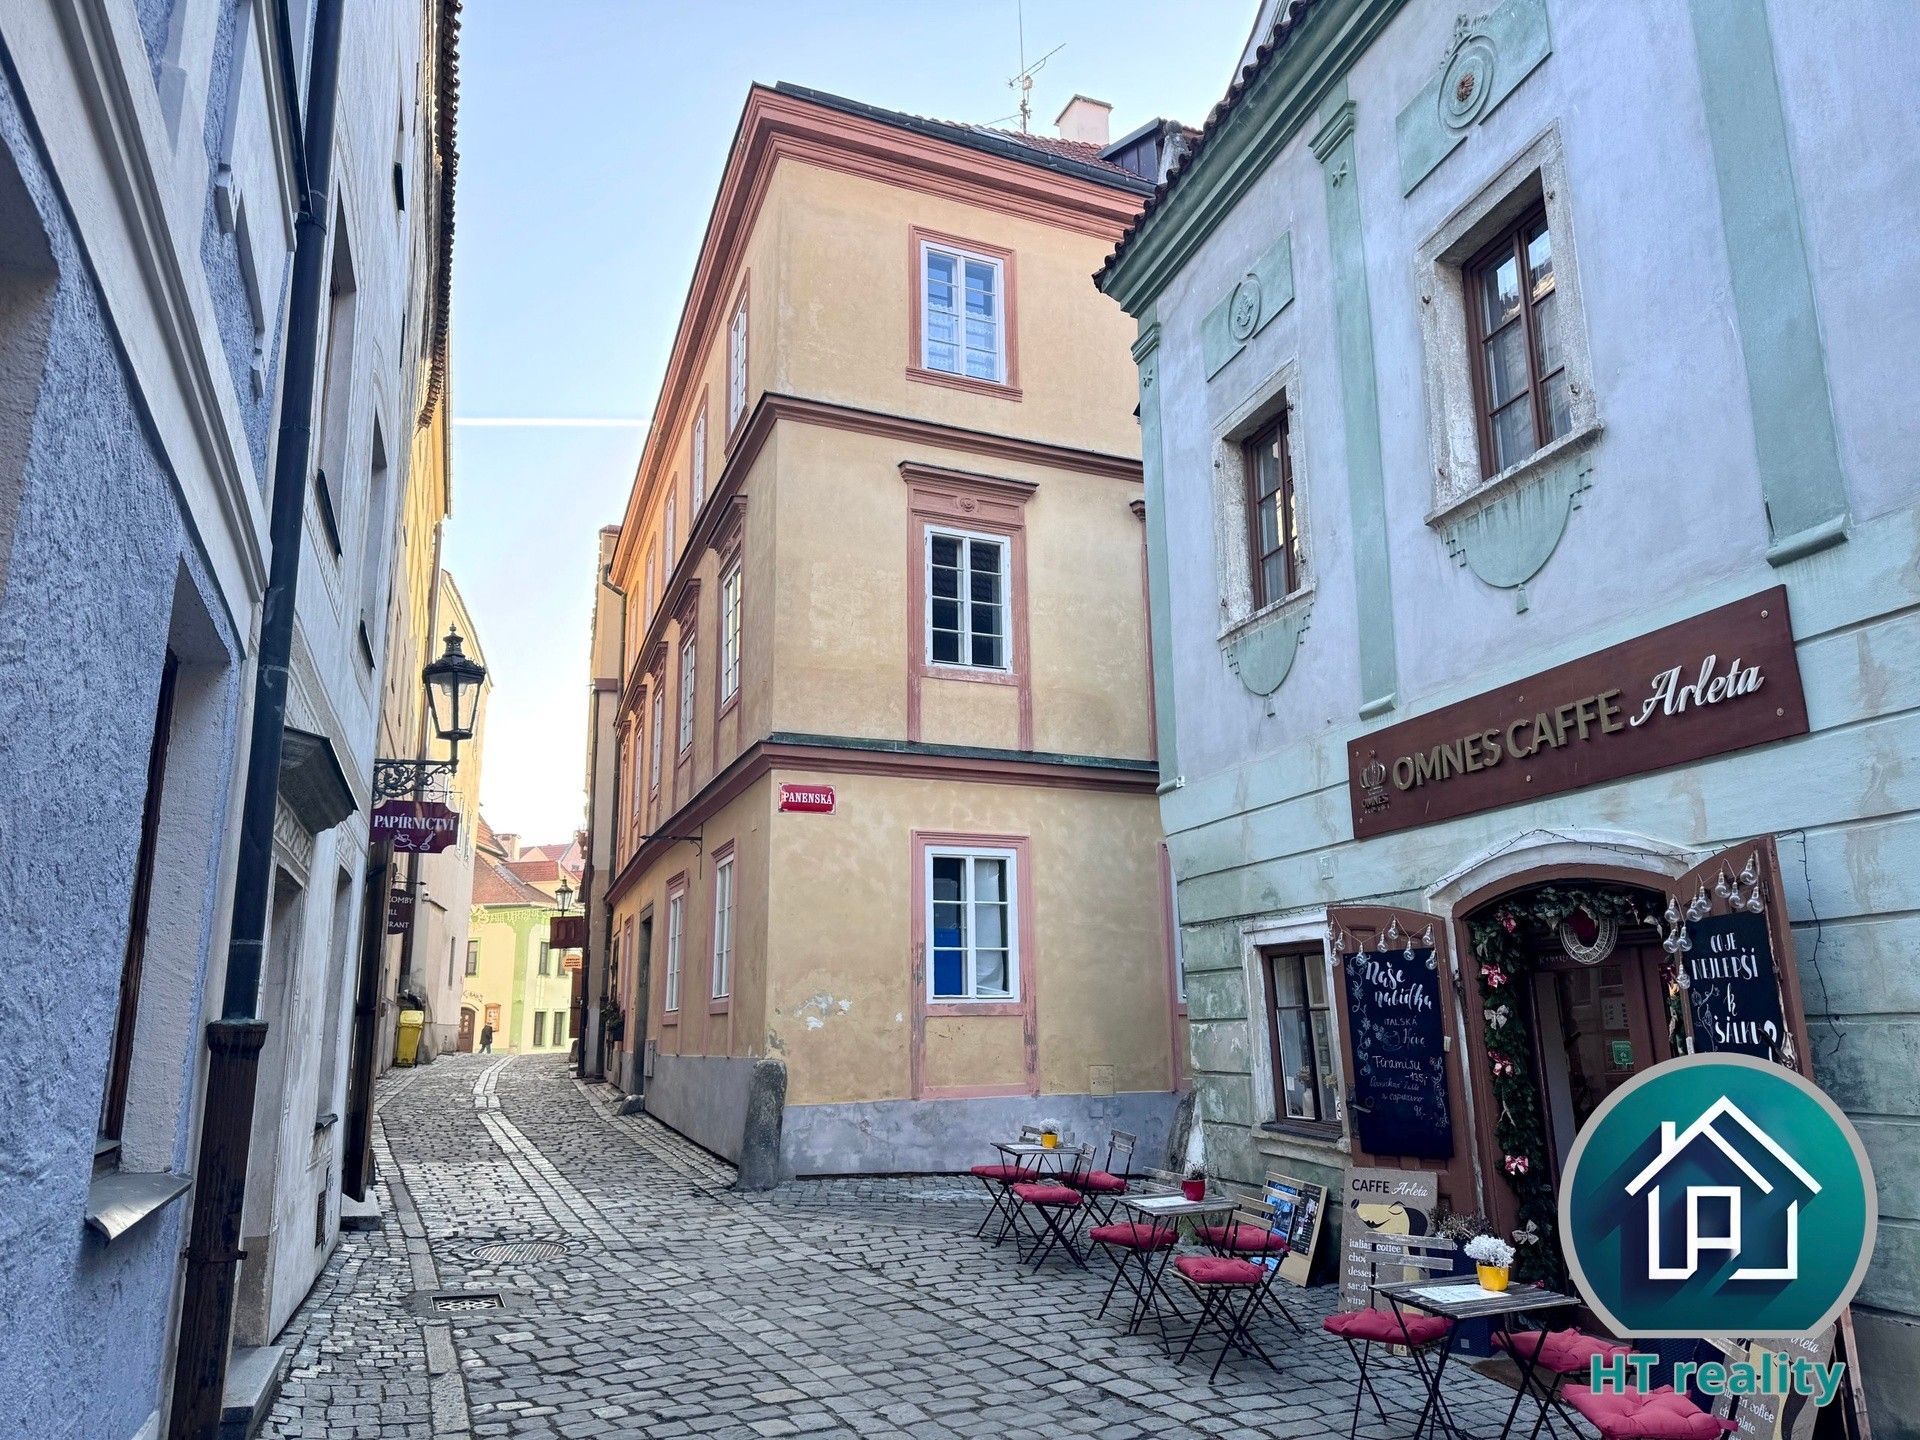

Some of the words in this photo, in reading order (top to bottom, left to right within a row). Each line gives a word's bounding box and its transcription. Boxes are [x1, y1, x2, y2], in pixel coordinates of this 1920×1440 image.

[1392, 727, 1501, 791] OMNES
[1505, 687, 1626, 760] CAFFE
[1629, 653, 1765, 728] Arleta
[783, 791, 833, 805] PANENSKÁ
[373, 812, 457, 831] PAPÍRNICTVÍ
[390, 896, 413, 904] OMBY
[388, 921, 410, 929] RANT
[1710, 933, 1722, 954] CO
[1724, 932, 1738, 952] JE
[1691, 947, 1759, 980] NEJLEPŠÍ
[1365, 961, 1405, 990] Naše
[1723, 982, 1738, 1016] k
[1351, 1178, 1391, 1194] CAFFE
[1391, 1181, 1429, 1198] Arleta
[1346, 1295, 1367, 1307] wine
[1749, 1402, 1775, 1424] coffee
